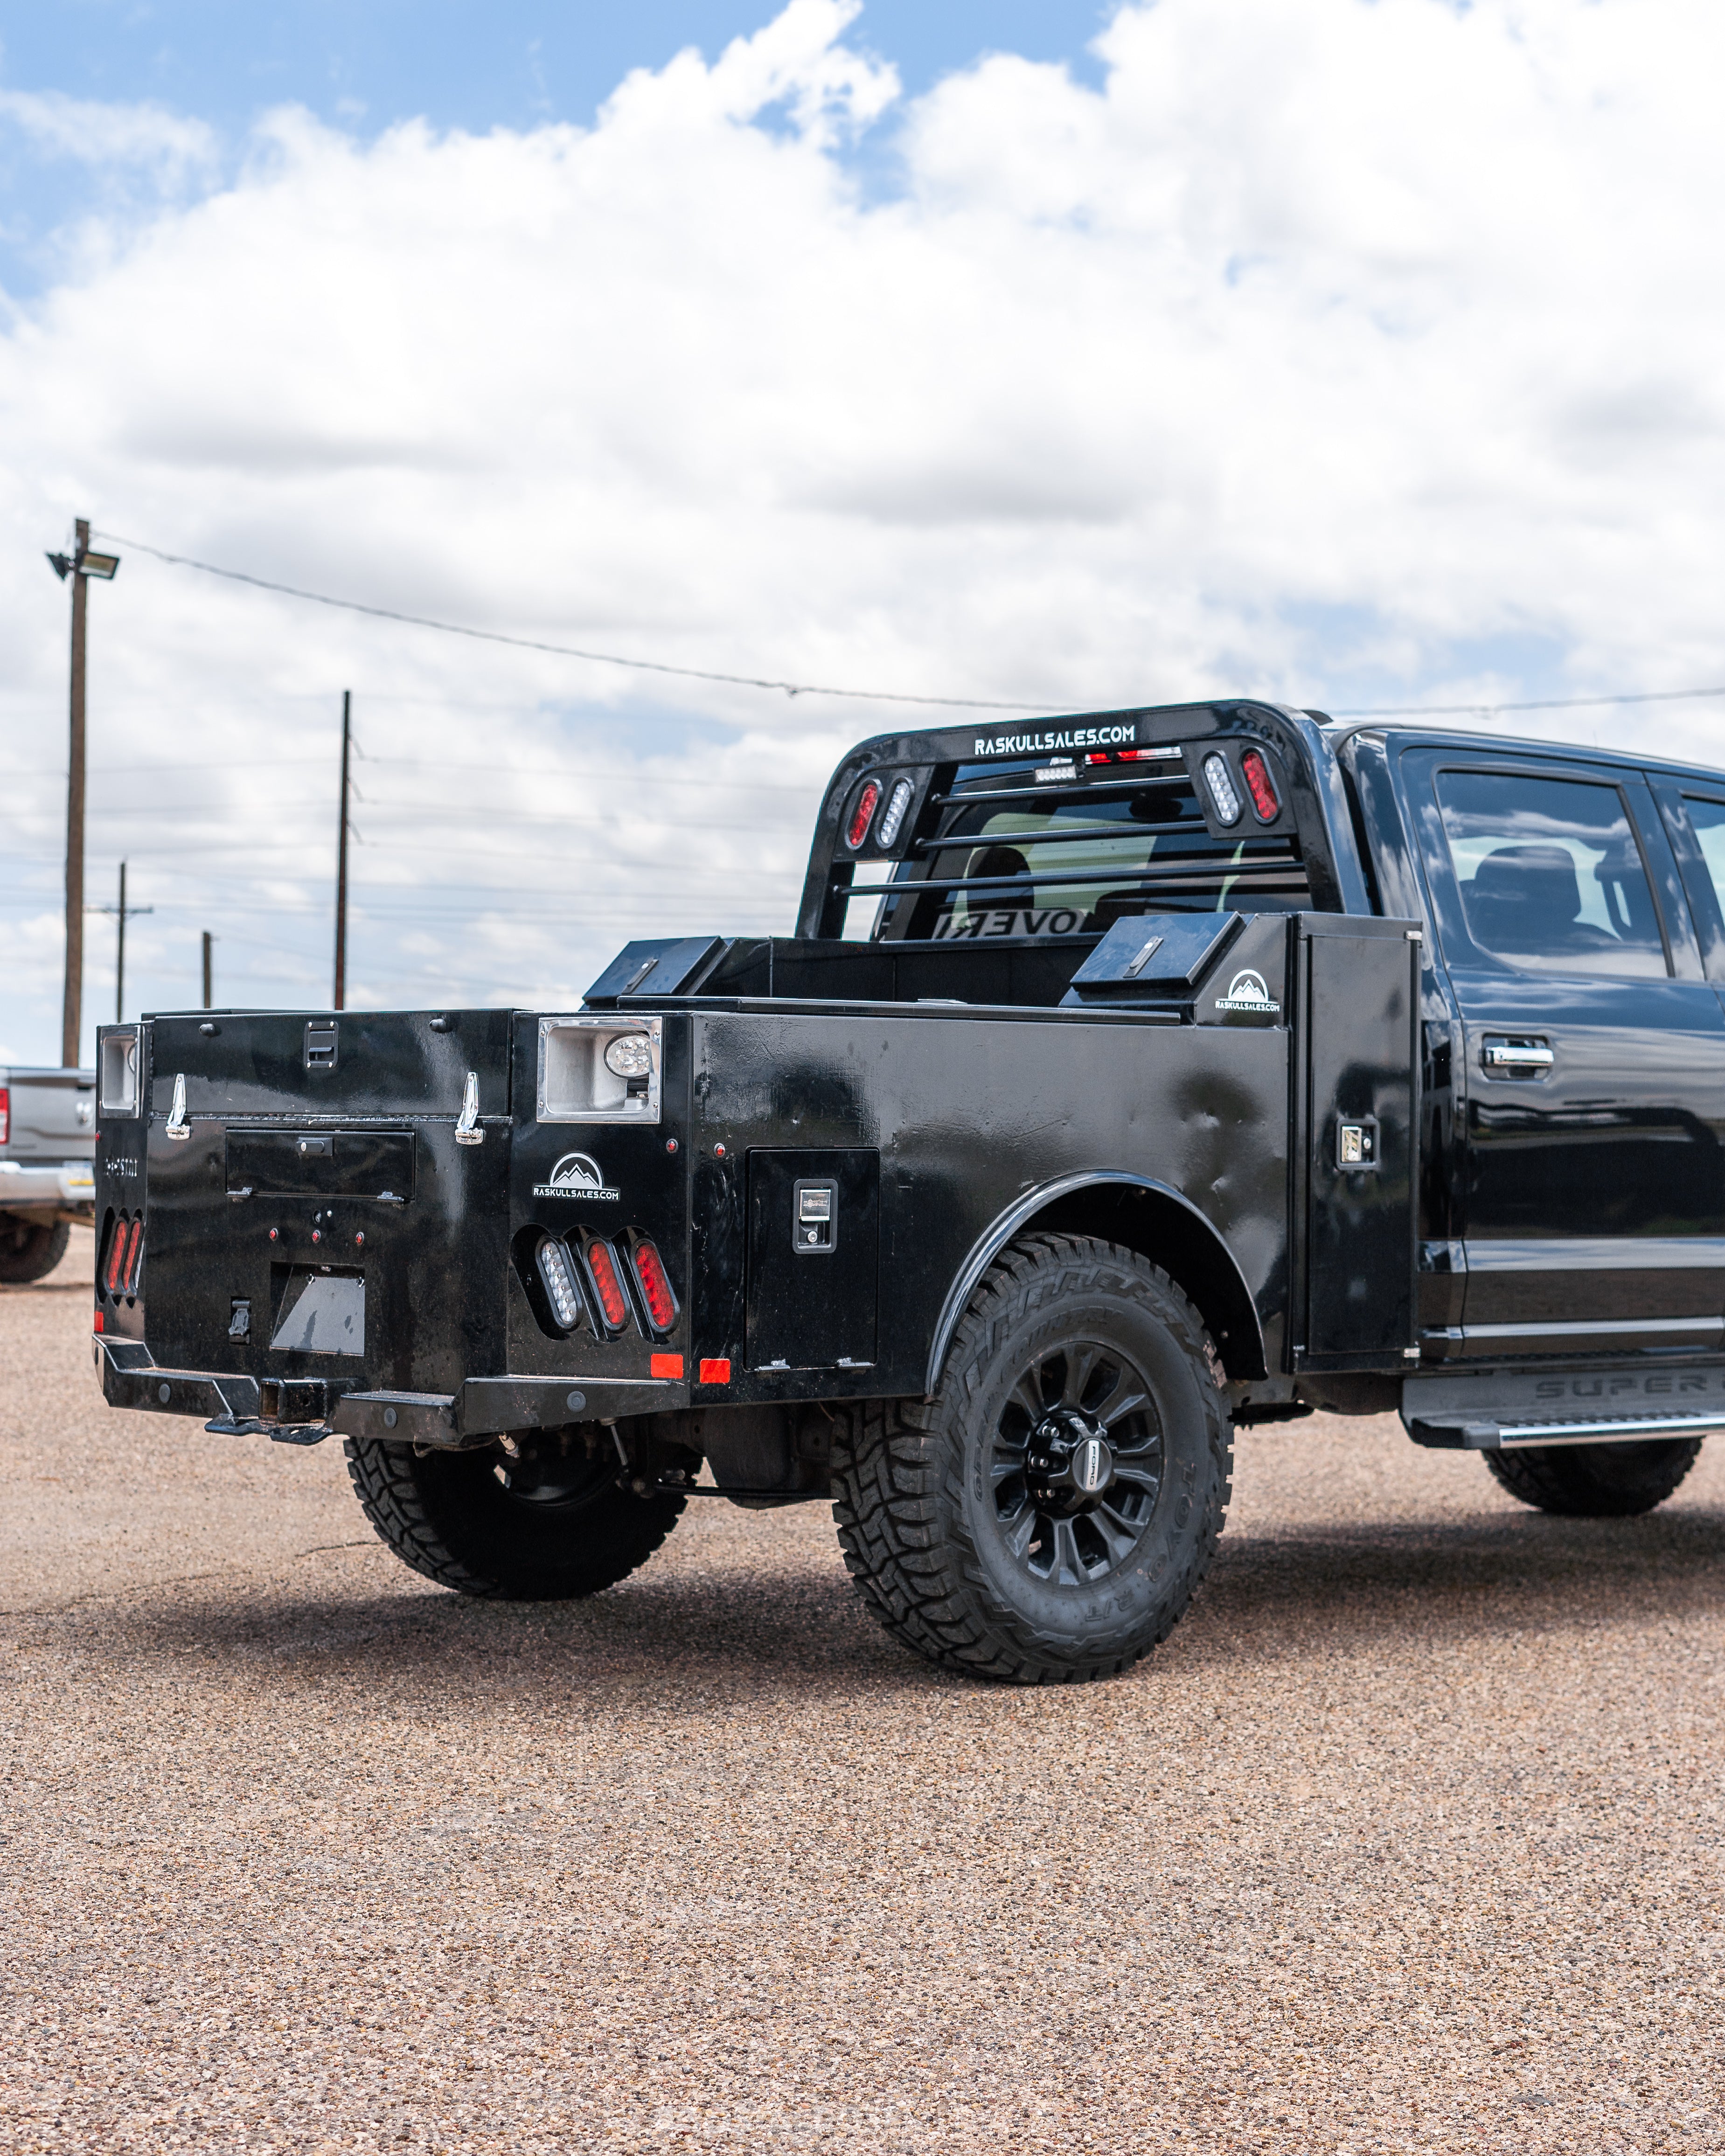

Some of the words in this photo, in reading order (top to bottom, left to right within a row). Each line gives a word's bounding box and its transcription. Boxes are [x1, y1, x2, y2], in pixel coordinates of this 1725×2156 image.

[974, 725, 1135, 755] RASKULLSALES.COM
[1215, 1000, 1280, 1012] RASKULLSALES.COM
[533, 1187, 619, 1200] RASKULLSALES.COM
[1536, 1374, 1707, 1399] SUPER
